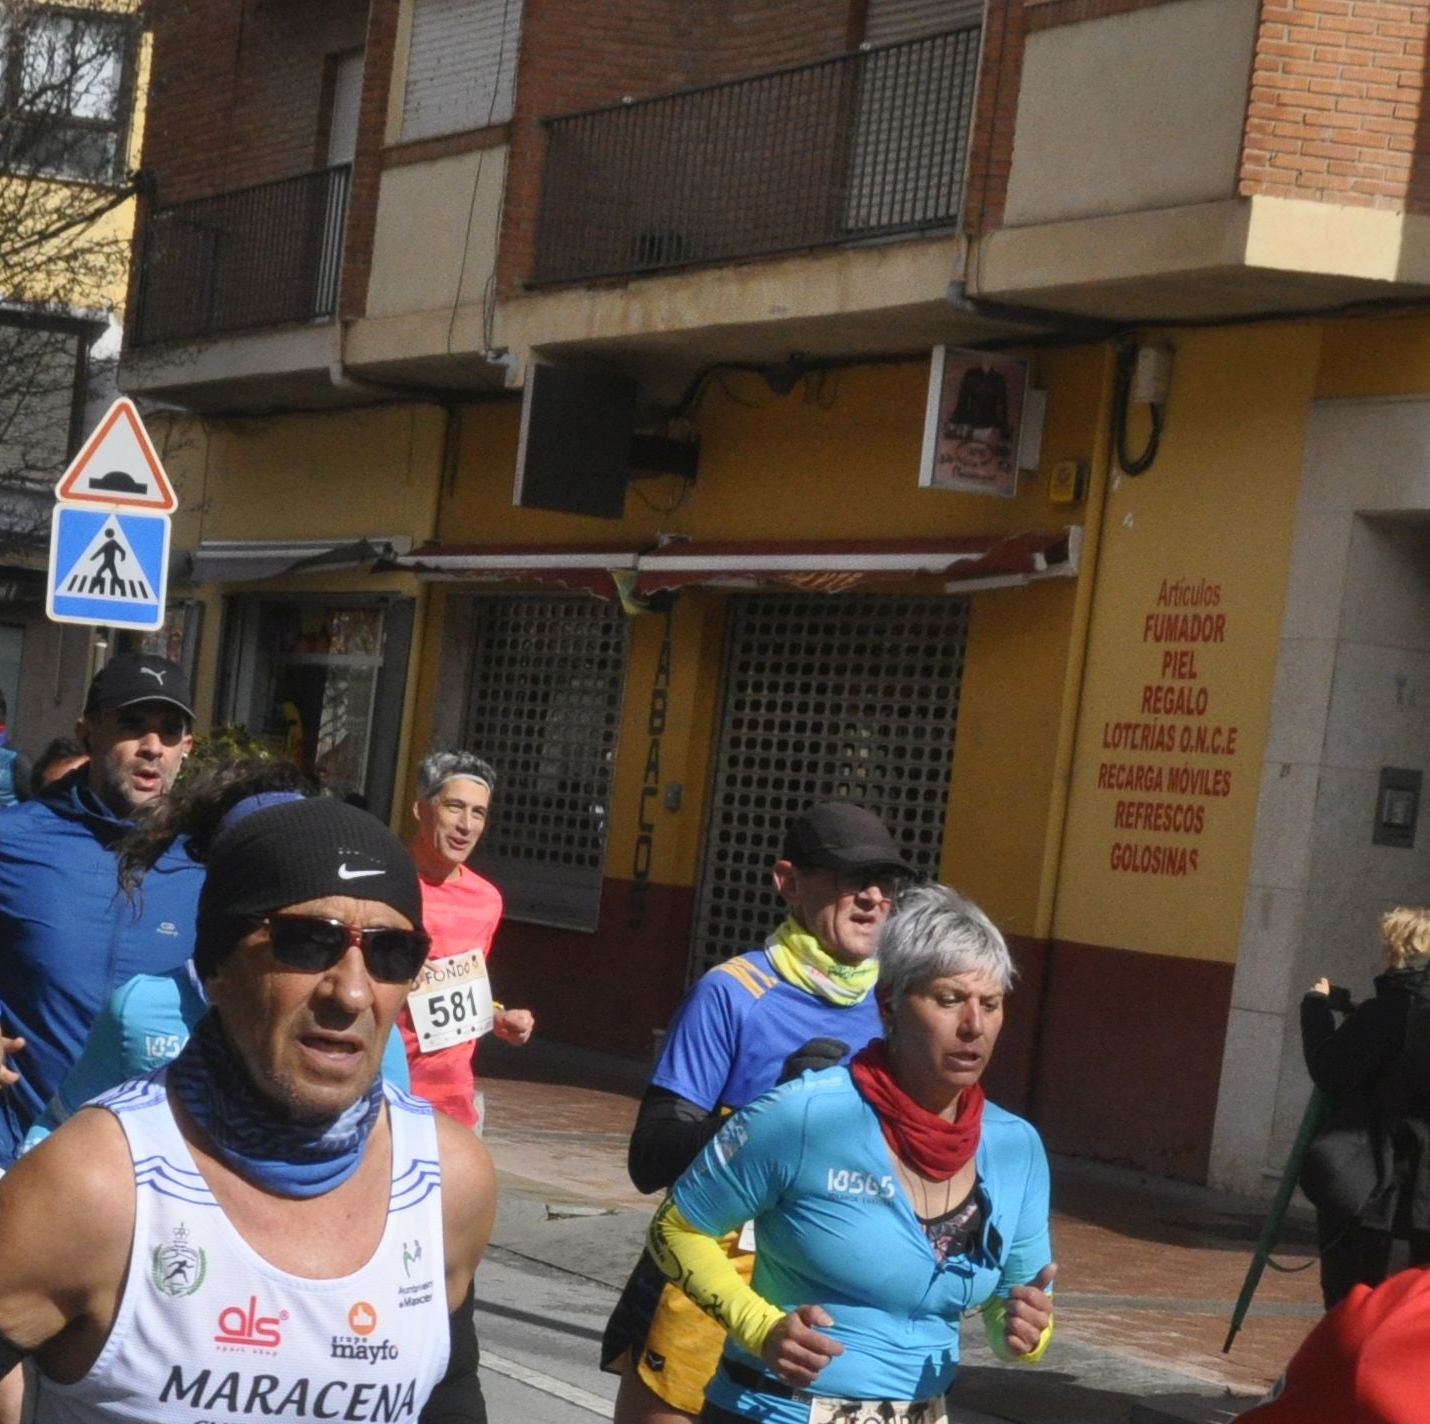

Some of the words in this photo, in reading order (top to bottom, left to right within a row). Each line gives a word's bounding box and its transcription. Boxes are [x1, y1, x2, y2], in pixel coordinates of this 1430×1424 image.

[1157, 577, 1221, 608] Artículos
[1143, 612, 1226, 643] FUMADOR
[1162, 650, 1198, 680] PIEL
[1141, 684, 1209, 716] REGALO
[1097, 762, 1163, 793] RECARGA
[1166, 762, 1232, 798] MÓVILES
[1114, 799, 1205, 835] REFRESCOS
[427, 989, 478, 1029] 581
[330, 1340, 399, 1365] mayfo
[158, 1365, 418, 1424] MARACENA
